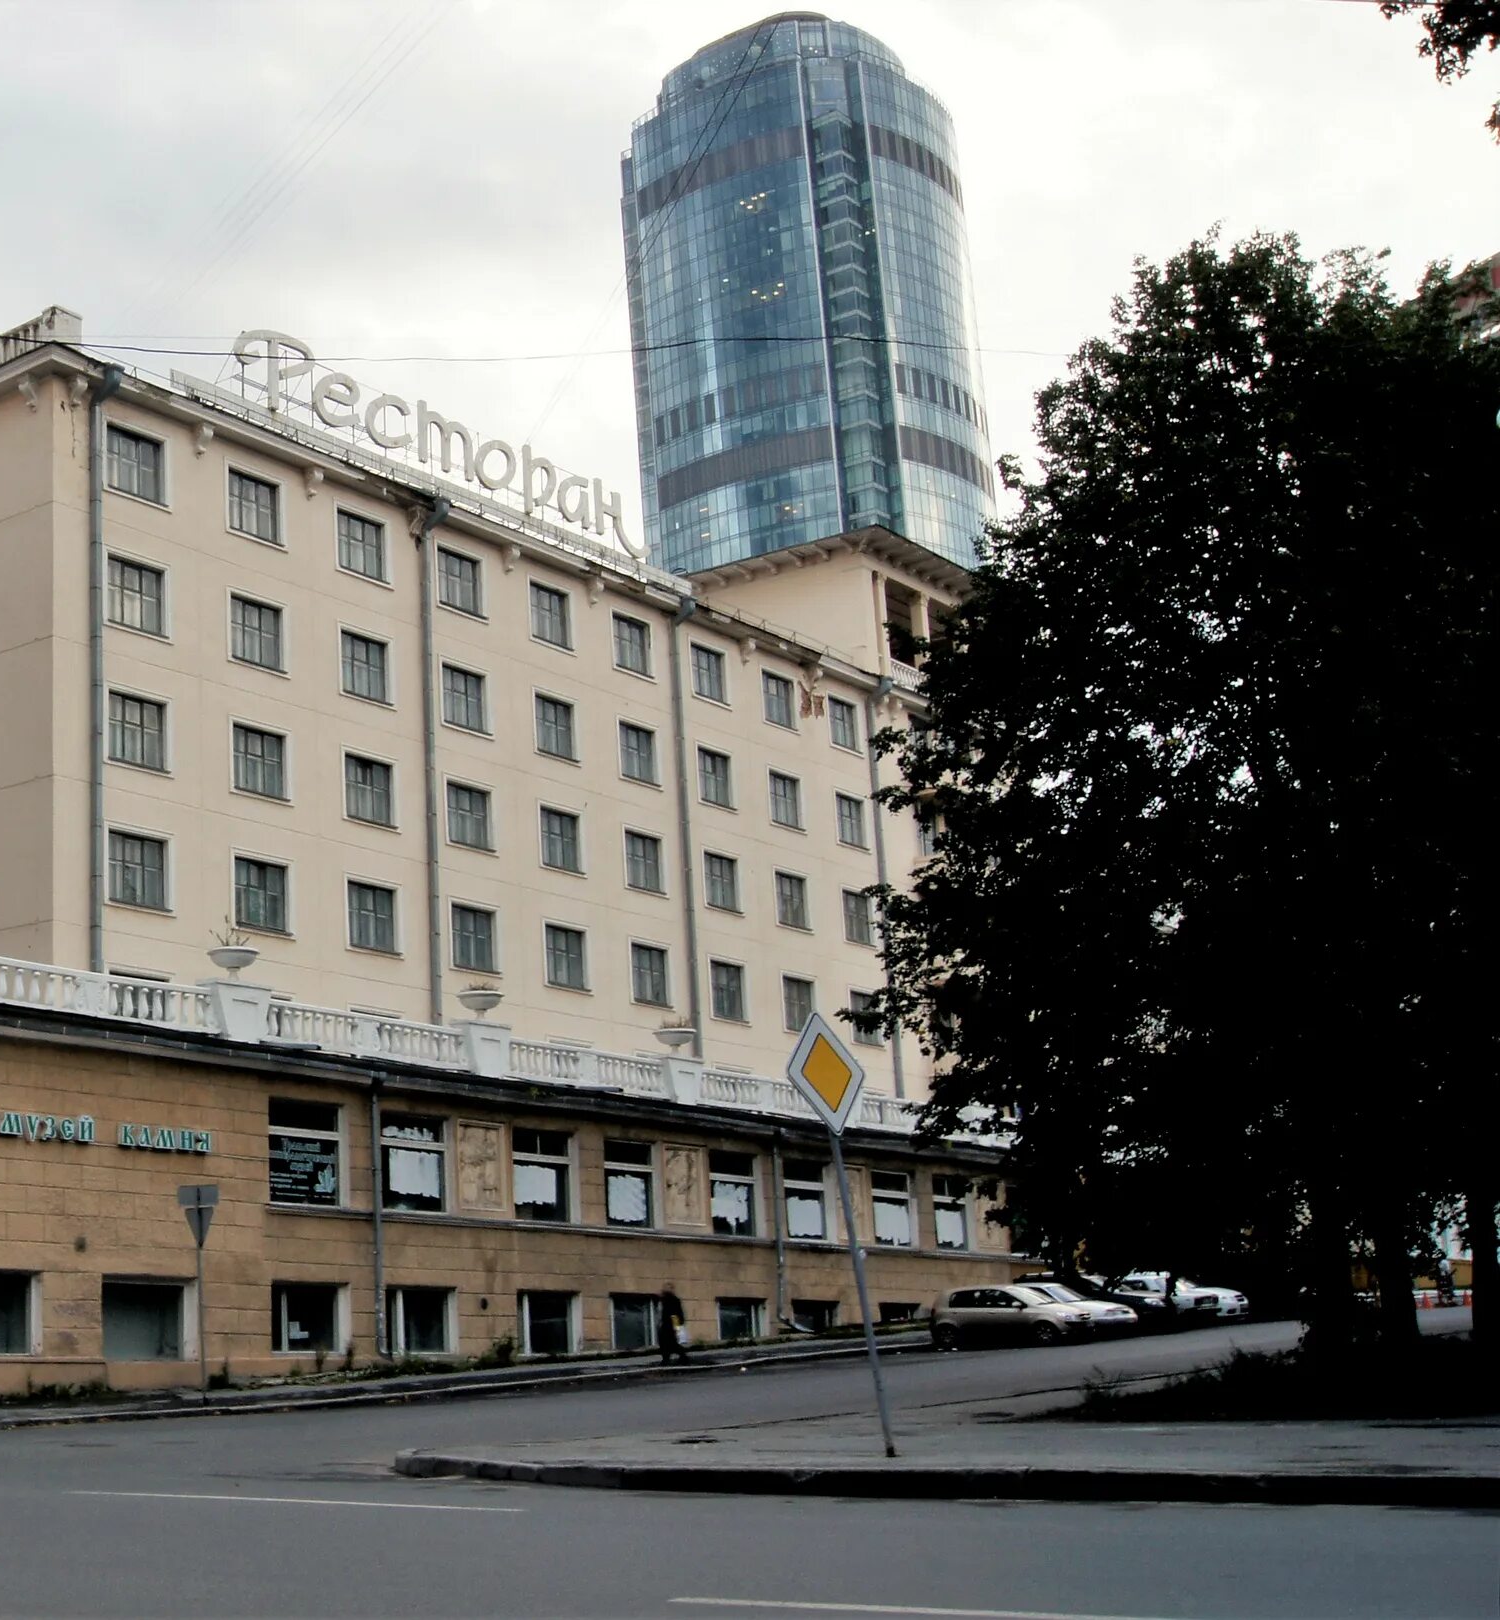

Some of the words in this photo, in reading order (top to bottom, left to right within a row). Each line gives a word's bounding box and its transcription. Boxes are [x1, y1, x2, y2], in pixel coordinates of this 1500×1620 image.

[233, 329, 651, 559] Ресторан
[0, 1112, 95, 1142] МУЗЕЙ
[121, 1123, 212, 1153] КАМНЯ
